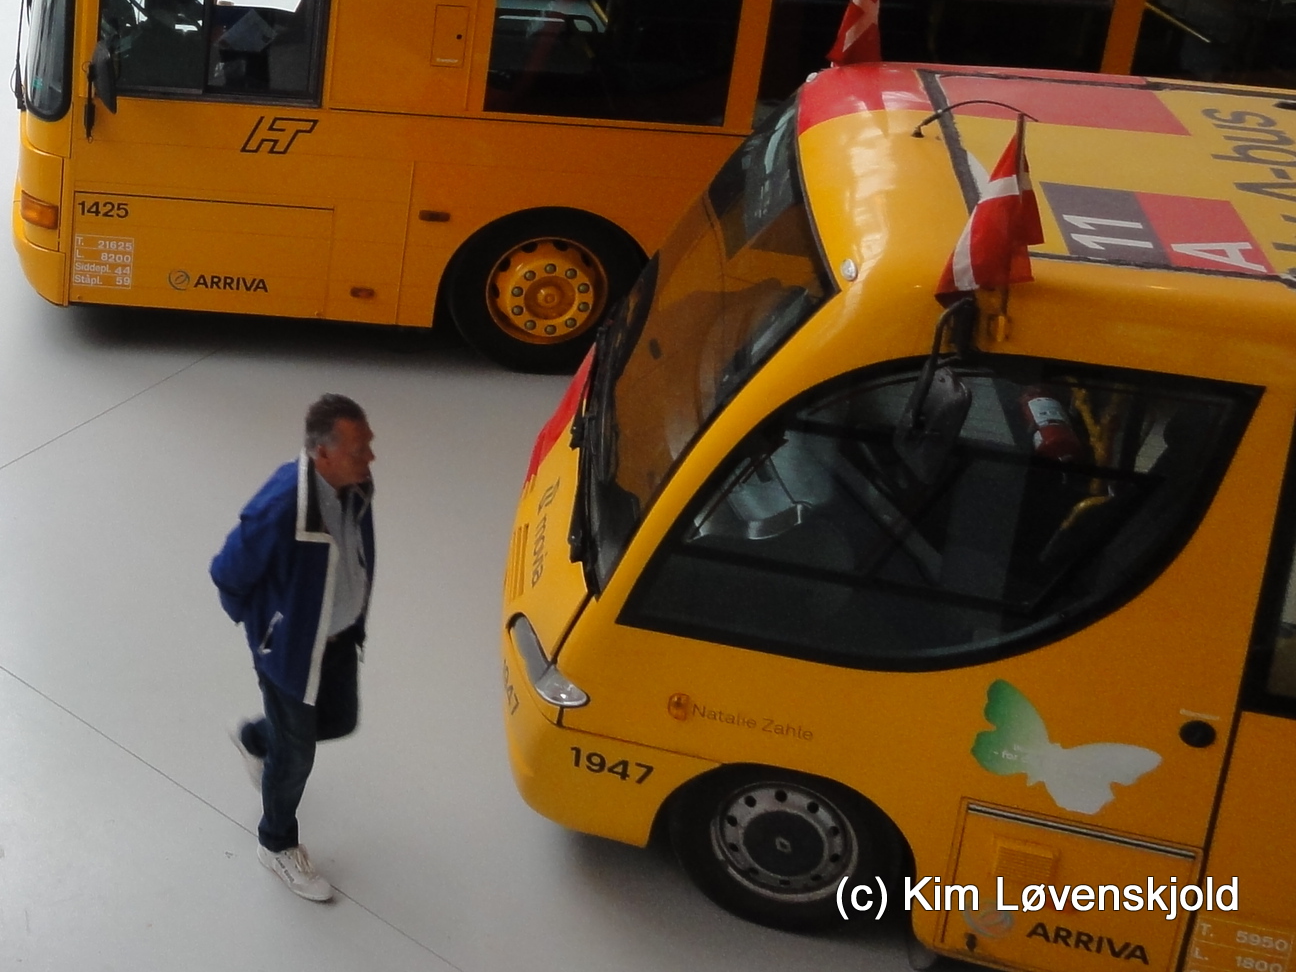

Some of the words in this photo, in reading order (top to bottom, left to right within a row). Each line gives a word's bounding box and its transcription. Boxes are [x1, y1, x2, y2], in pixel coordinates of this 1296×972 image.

[240, 116, 319, 154] HT
[78, 201, 129, 219] 1425
[1062, 214, 1153, 250] 11
[98, 240, 132, 251] 21625
[101, 252, 131, 263] 8200
[1170, 241, 1267, 273] A
[75, 262, 111, 274] Siddepl.
[115, 266, 130, 275] 44
[74, 274, 102, 286] Ståpl.
[116, 276, 130, 285] 59
[194, 274, 269, 293] ARRIVA
[692, 703, 757, 729] Natalie
[762, 718, 814, 742] Zahle
[570, 746, 655, 785] 1947
[1026, 922, 1150, 965] ARRIVA
[1235, 930, 1289, 951] 5950
[1235, 956, 1283, 972] 1800
